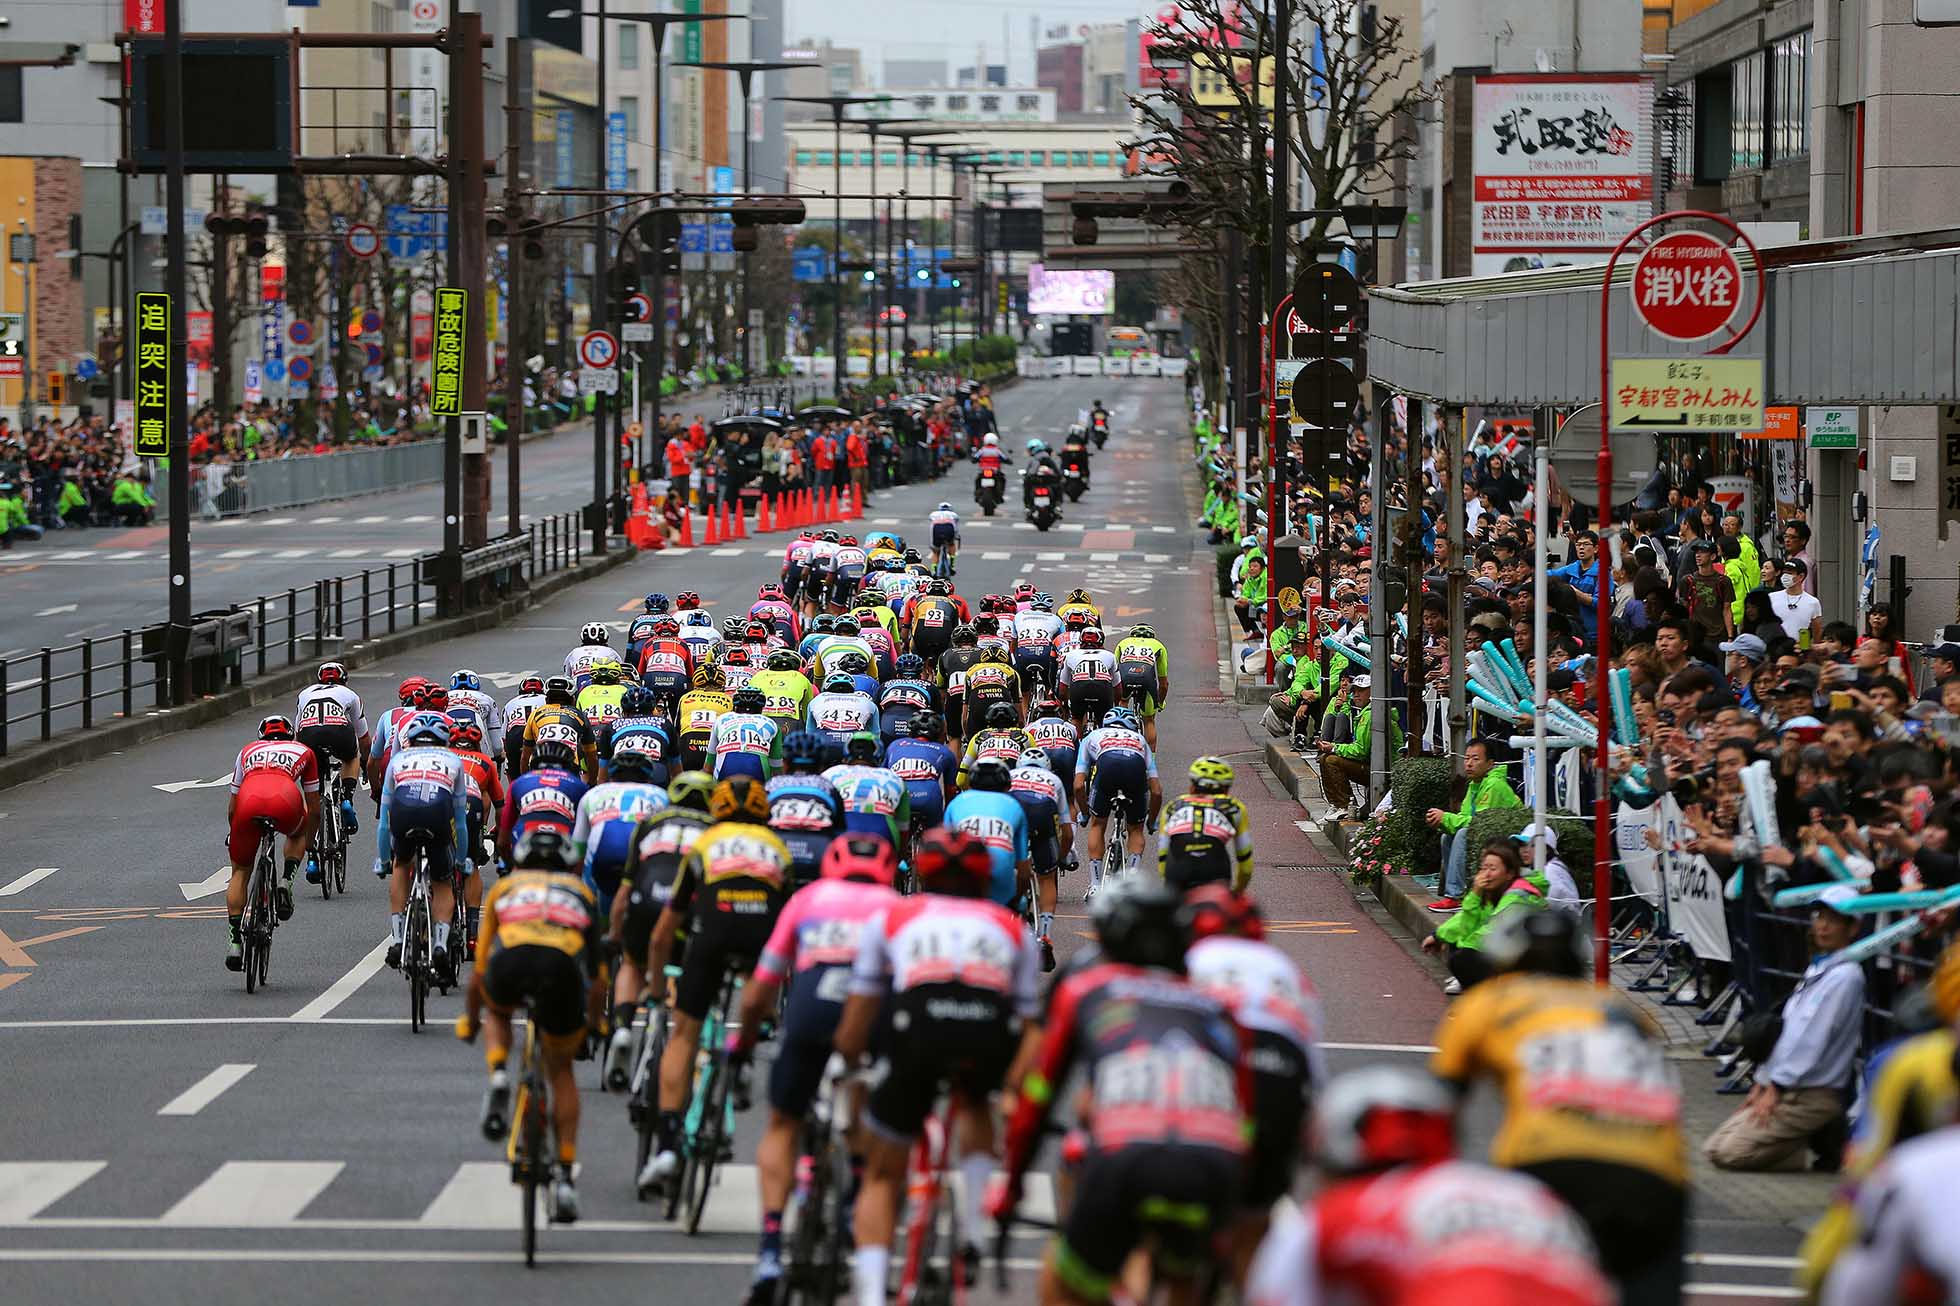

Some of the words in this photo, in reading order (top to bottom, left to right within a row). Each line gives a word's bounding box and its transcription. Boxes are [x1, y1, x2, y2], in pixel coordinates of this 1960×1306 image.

[1651, 246, 1674, 259] FIRE
[1676, 247, 1723, 259] HYDRANT
[1642, 265, 1734, 307] 消火栓
[434, 292, 462, 411] 事故危険箇所
[139, 303, 166, 446] 追突注意
[1618, 384, 1760, 409] 宇都宮みんみん
[1694, 413, 1753, 426] 手前信号
[927, 610, 941, 620] 93
[694, 711, 710, 721] 31
[540, 725, 557, 739] 95
[560, 726, 577, 743] 95
